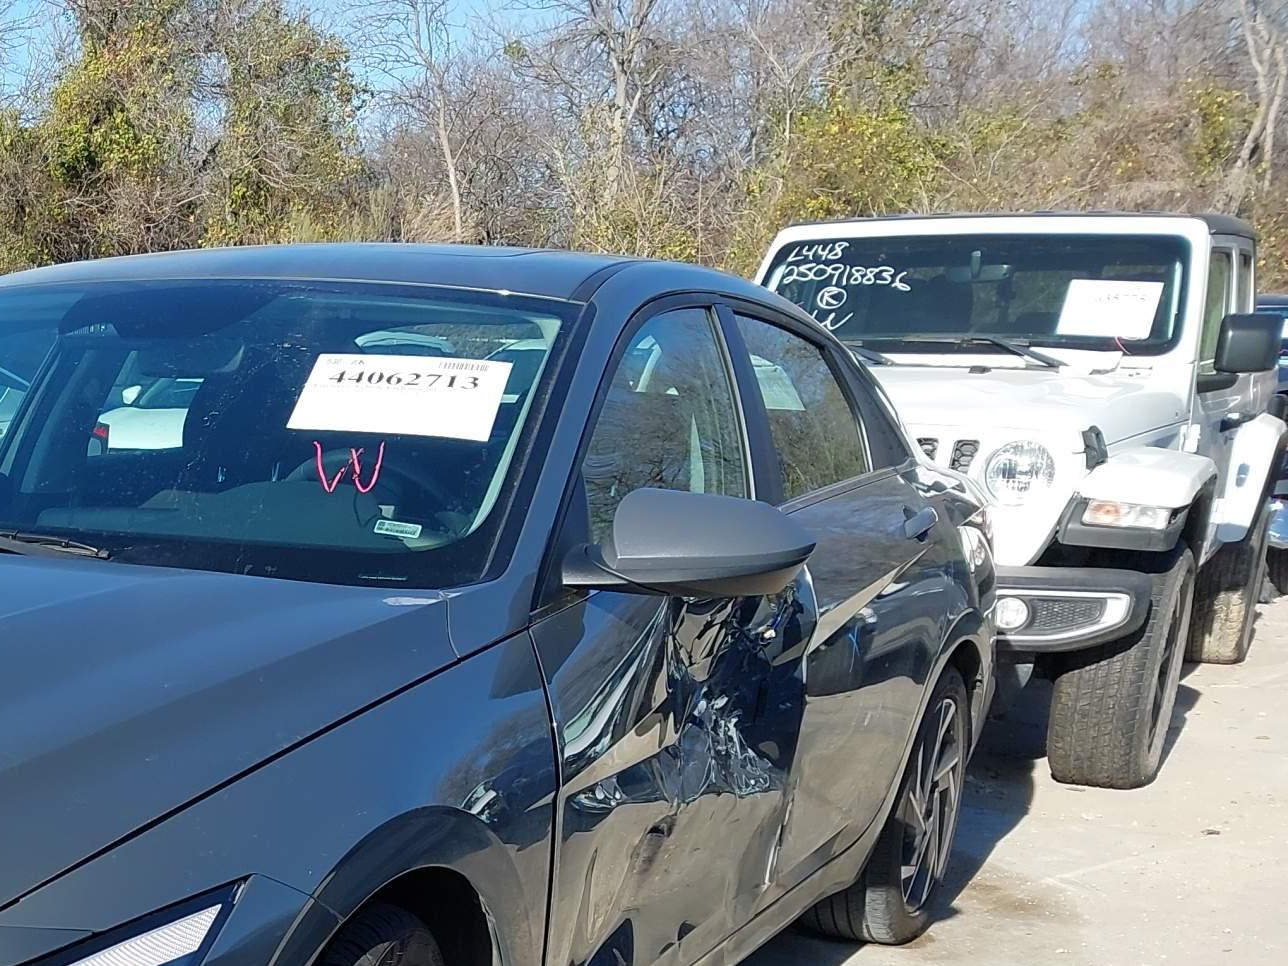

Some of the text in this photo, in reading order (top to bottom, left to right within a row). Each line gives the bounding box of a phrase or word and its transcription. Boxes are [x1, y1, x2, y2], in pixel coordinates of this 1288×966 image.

[787, 241, 849, 262] L448
[783, 263, 912, 291] 250918836
[328, 369, 480, 390] 44062713
